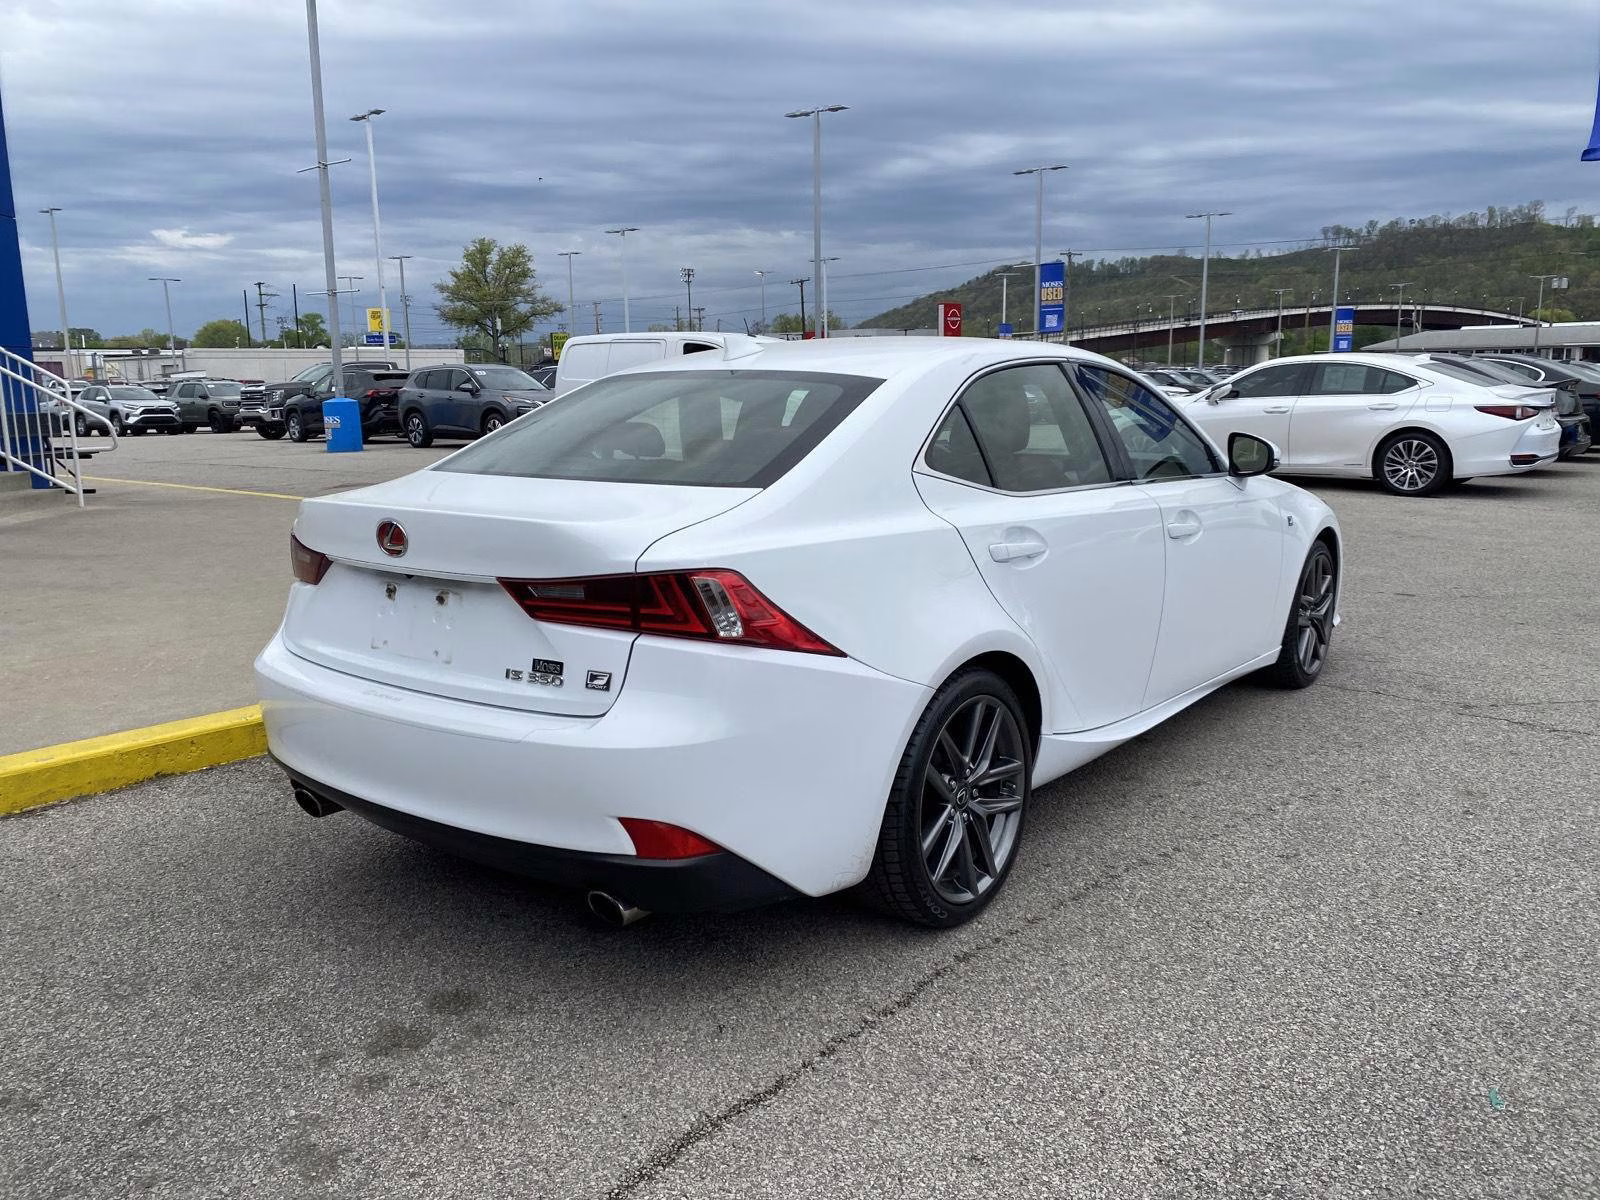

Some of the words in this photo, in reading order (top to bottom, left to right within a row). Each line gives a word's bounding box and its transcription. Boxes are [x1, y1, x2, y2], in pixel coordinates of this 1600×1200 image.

[1041, 287, 1063, 300] USED
[505, 668, 524, 681] IS
[527, 671, 564, 688] 350
[587, 683, 608, 691] SPORT
